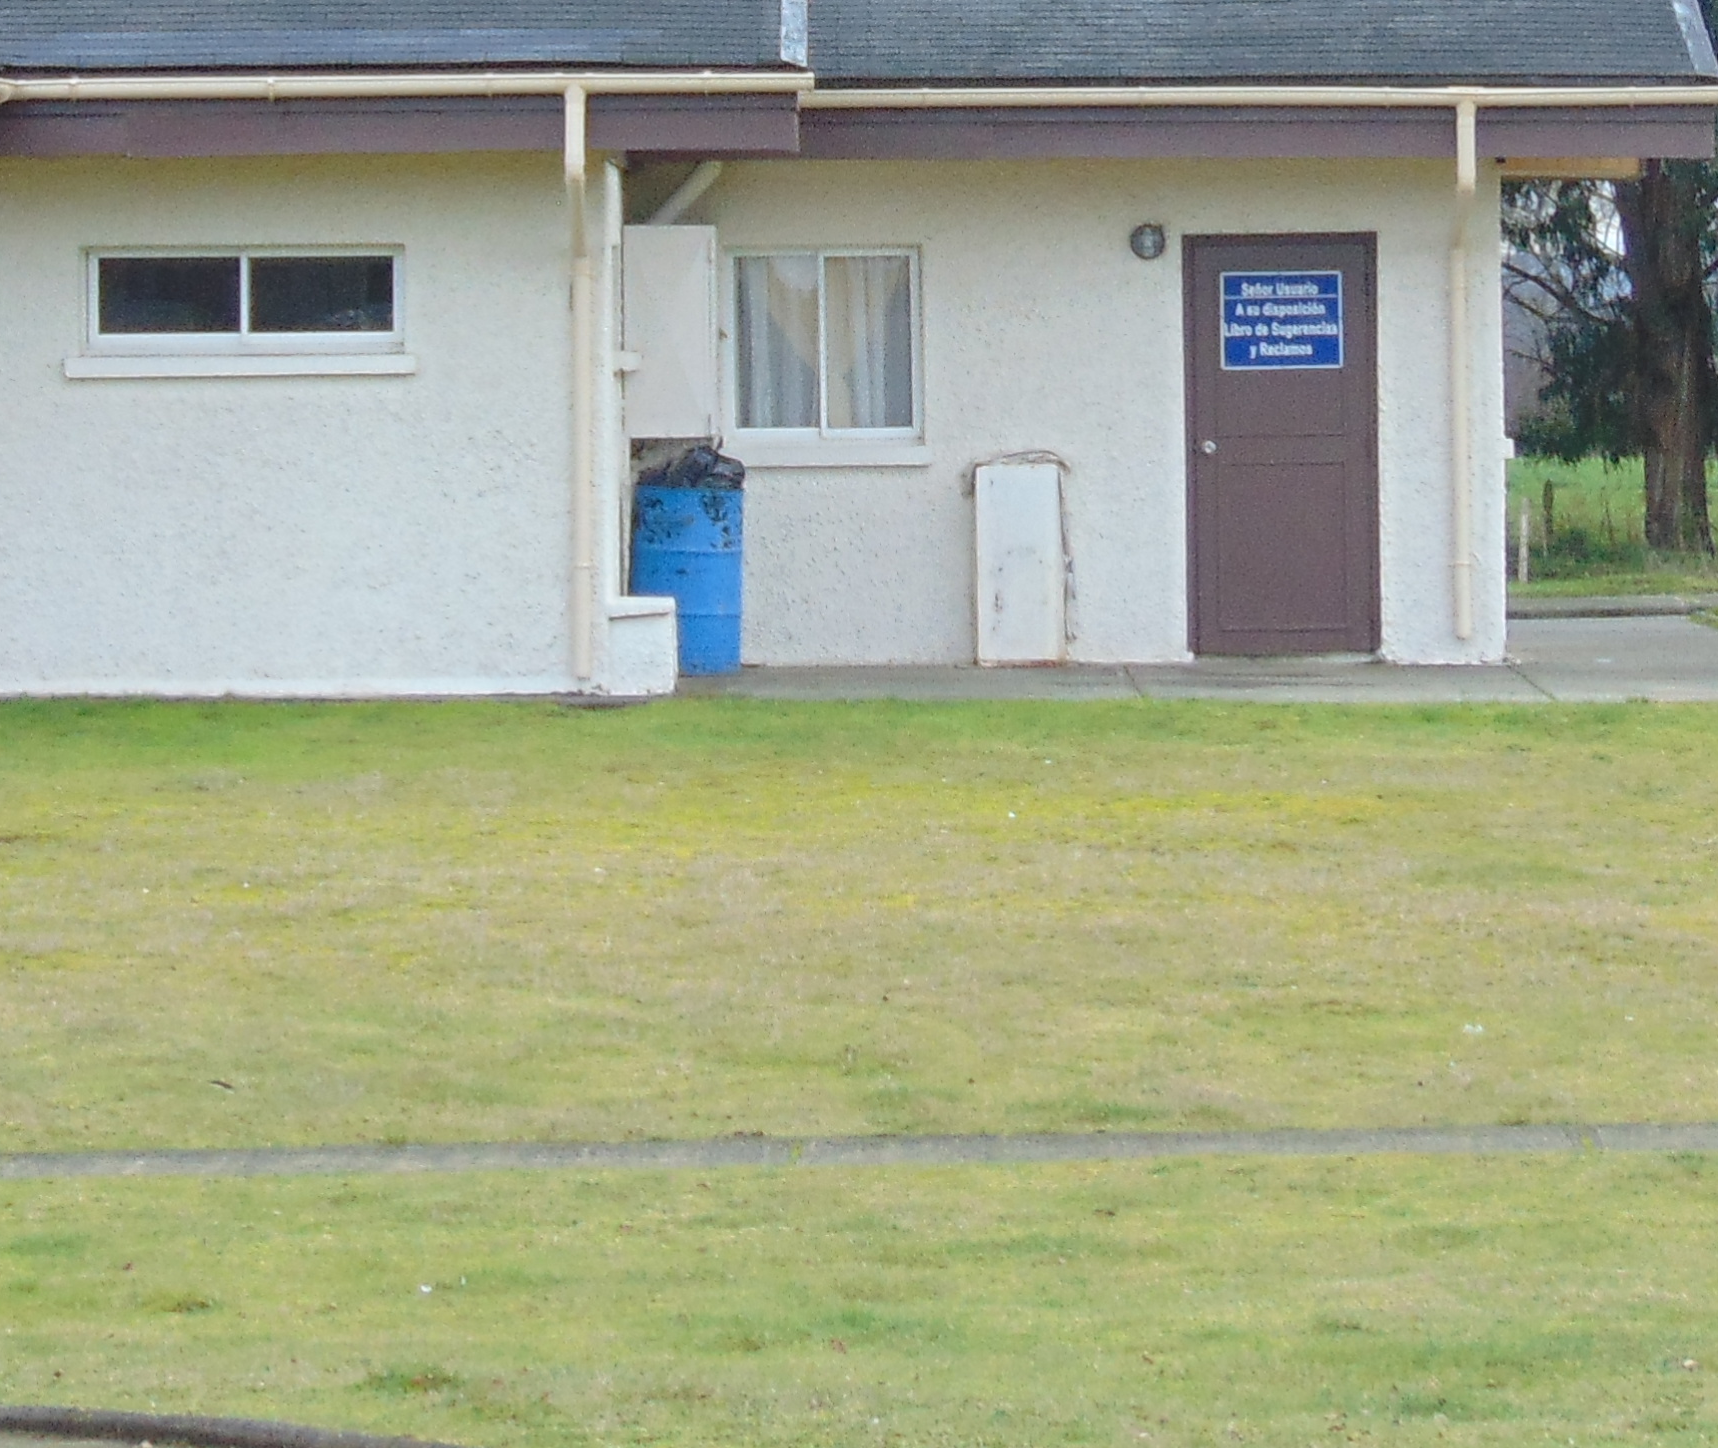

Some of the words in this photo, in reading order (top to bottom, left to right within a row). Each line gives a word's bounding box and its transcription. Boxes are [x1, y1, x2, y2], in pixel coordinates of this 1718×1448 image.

[1235, 303, 1244, 316] A
[1223, 322, 1253, 337] Libro
[1254, 323, 1269, 336] de
[1249, 345, 1257, 359] y
